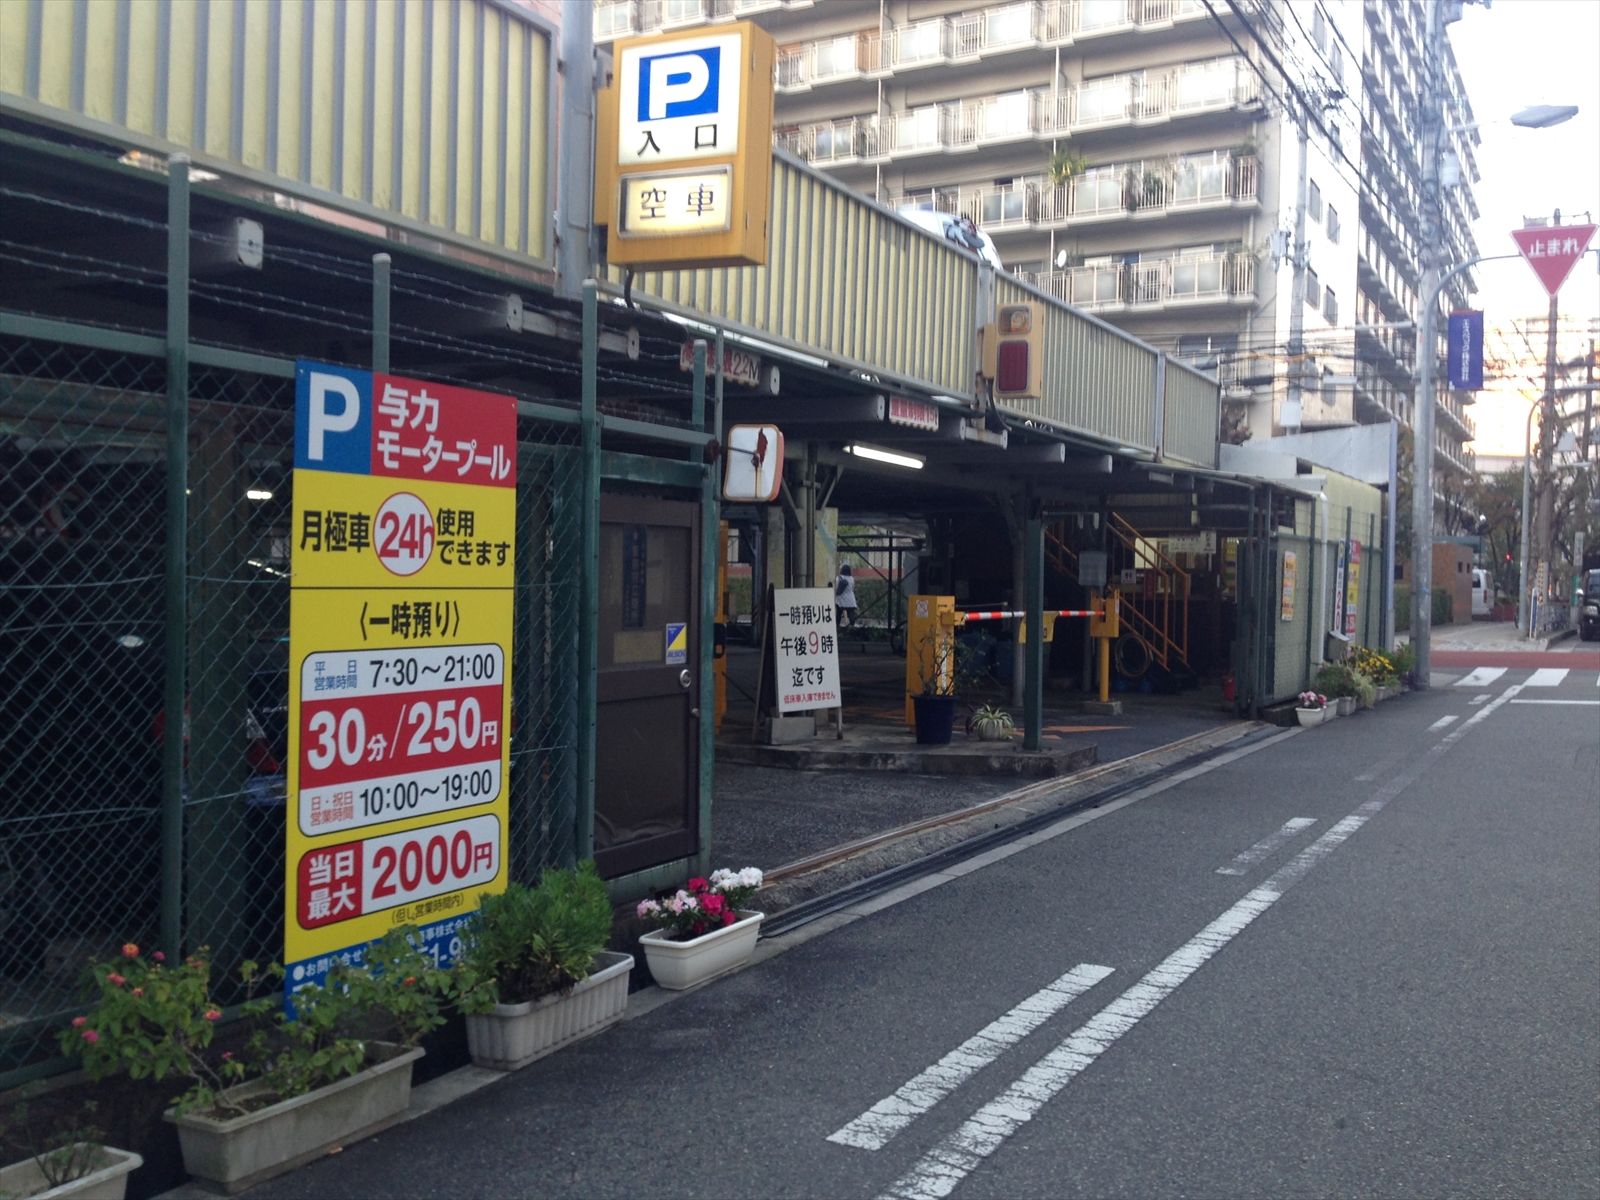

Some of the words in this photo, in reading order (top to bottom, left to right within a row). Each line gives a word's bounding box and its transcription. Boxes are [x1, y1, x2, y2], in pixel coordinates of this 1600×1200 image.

[649, 54, 709, 120] P
[637, 124, 717, 156] 入口
[639, 184, 714, 220] 空車
[1528, 237, 1579, 258] 止まれ
[308, 371, 360, 461] P
[378, 383, 439, 433] 与力
[377, 430, 511, 480] モータープール
[300, 510, 371, 553] 月極車
[379, 511, 434, 559] 24h
[436, 508, 475, 538] 使用
[436, 540, 511, 567] できます
[779, 605, 832, 625] 一時預りは
[780, 631, 834, 656] 午後9時
[314, 674, 358, 692] 営業時間
[792, 665, 825, 687] 迄です
[308, 849, 355, 886] 当日
[371, 829, 493, 901] 2000円
[308, 883, 356, 921] 最大
